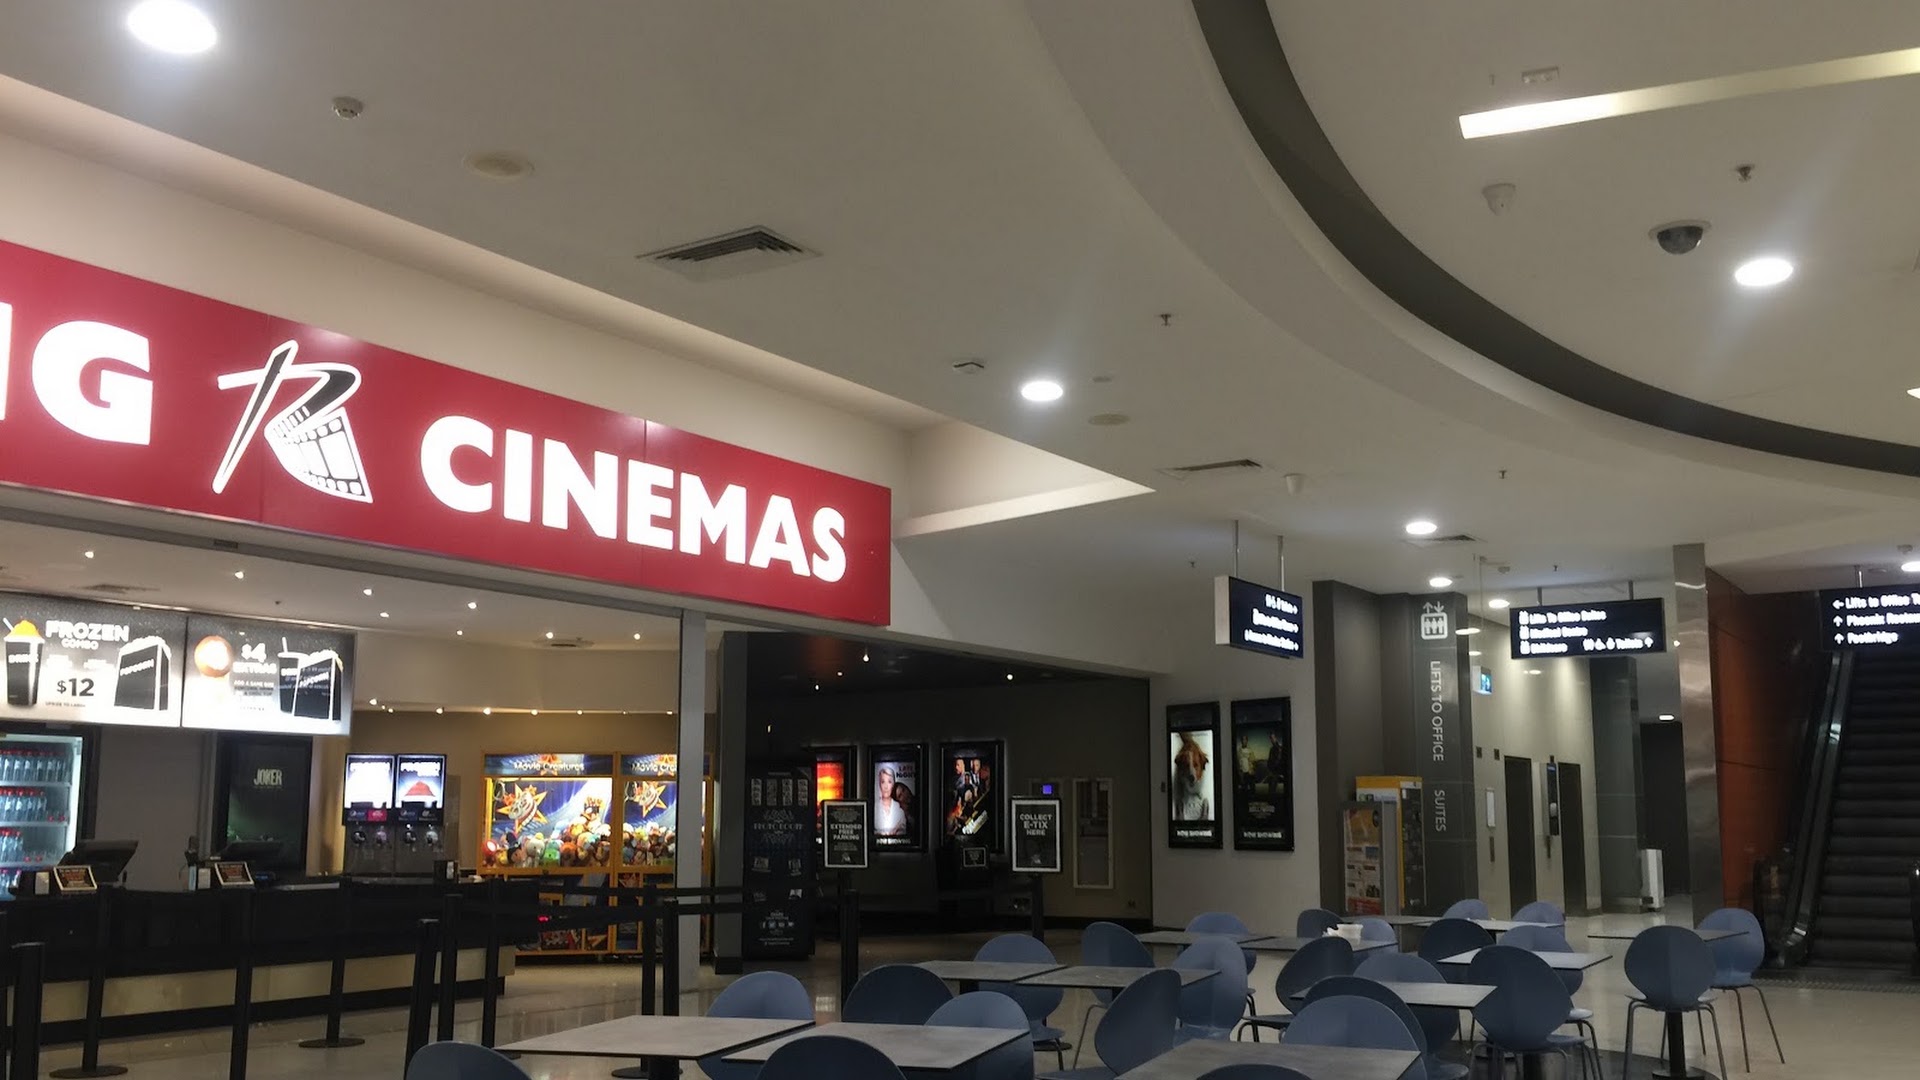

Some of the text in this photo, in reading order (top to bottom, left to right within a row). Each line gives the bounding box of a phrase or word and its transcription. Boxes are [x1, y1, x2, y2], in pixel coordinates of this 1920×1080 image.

[420, 415, 847, 583] CINEMAS
[46, 620, 129, 642] FROZEN
[61, 638, 99, 650] COMBO
[56, 677, 95, 697] $12
[1429, 661, 1447, 832] LIFTS TO OFFICE SUITES
[514, 761, 585, 772] Movie Creatures
[632, 762, 659, 773] Movie
[253, 768, 283, 786] JOKER
[1019, 813, 1053, 821] COLLECT
[1023, 821, 1048, 829] E-TIX
